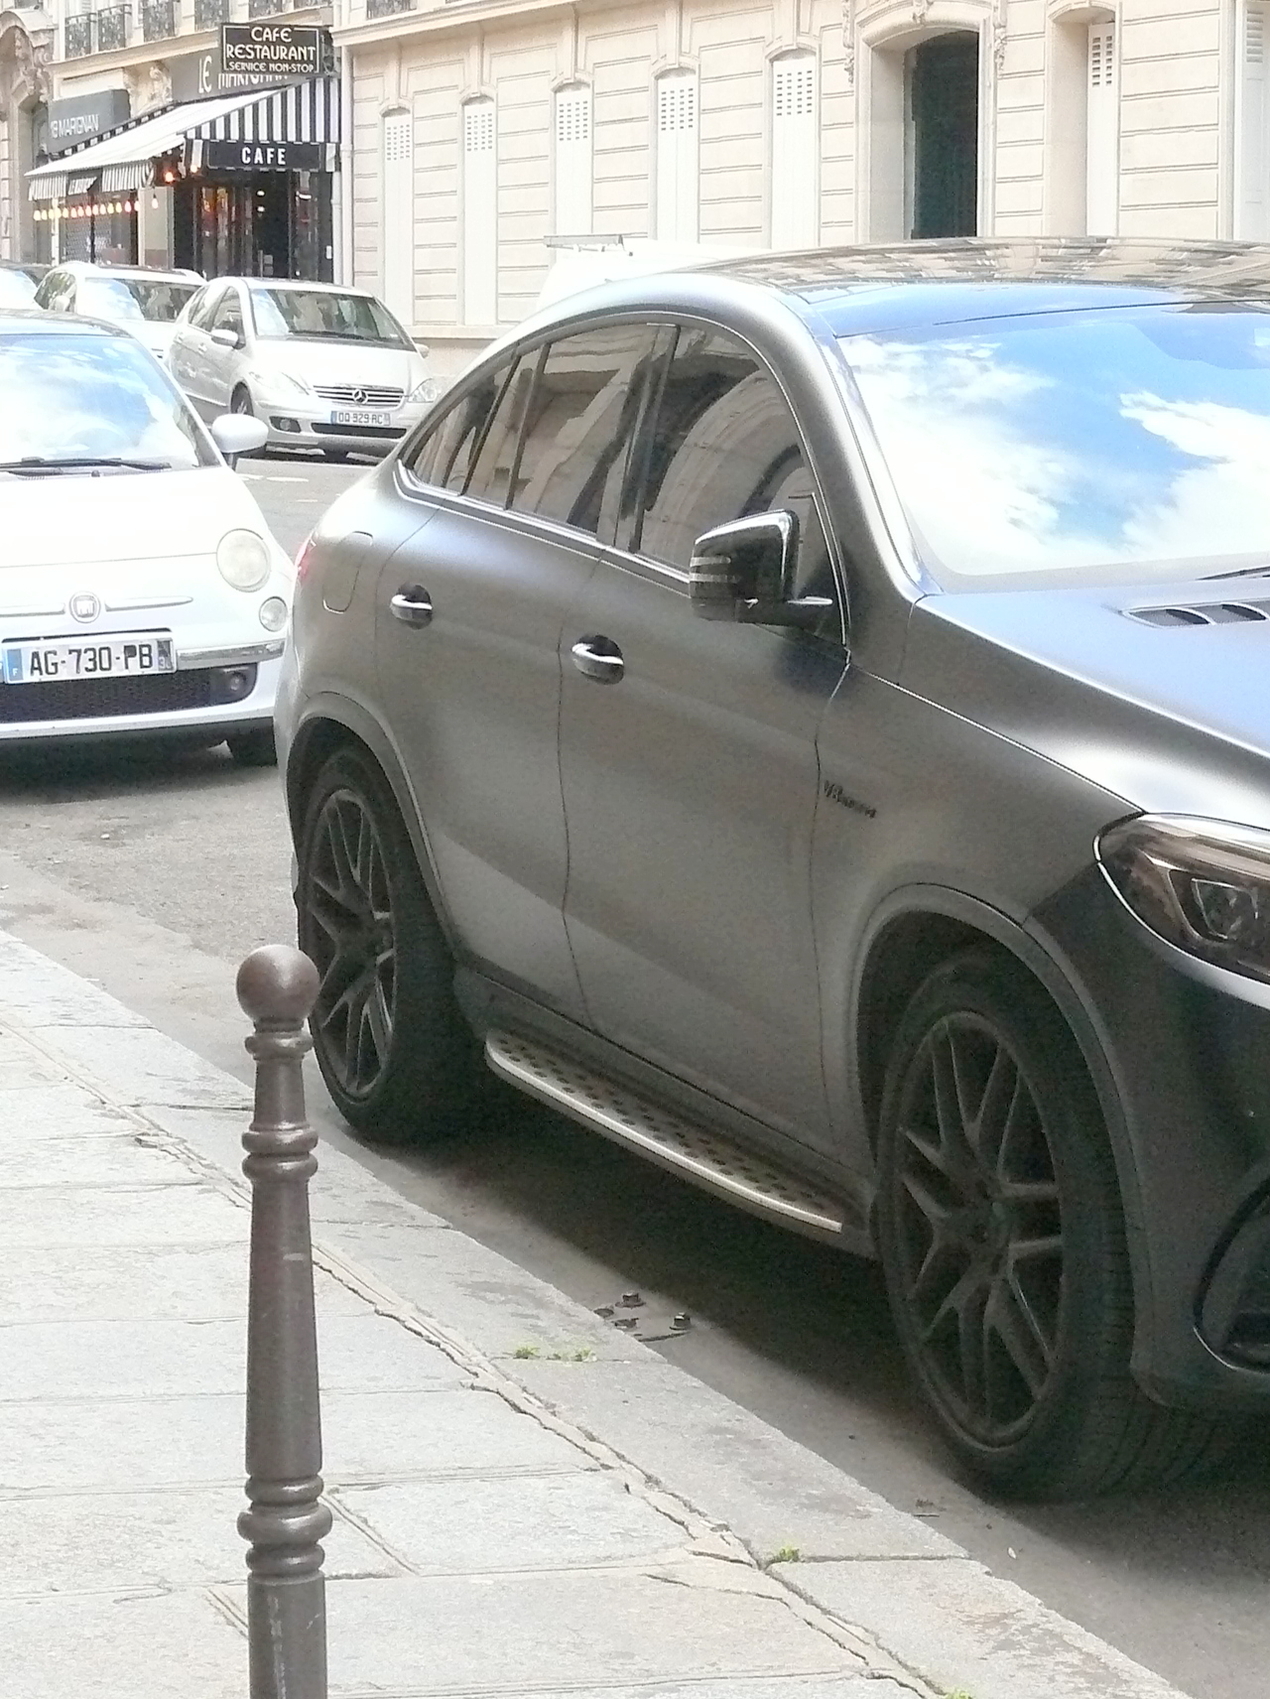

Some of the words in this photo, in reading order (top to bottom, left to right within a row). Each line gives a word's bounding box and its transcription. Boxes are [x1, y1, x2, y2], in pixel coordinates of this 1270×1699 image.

[251, 27, 292, 42] CAFE
[226, 44, 316, 60] RESTAURANT
[229, 61, 266, 71] SERVICE
[269, 62, 314, 73] NON-STOP
[241, 147, 287, 165] CAFE
[29, 643, 154, 677] AG-730-PB
